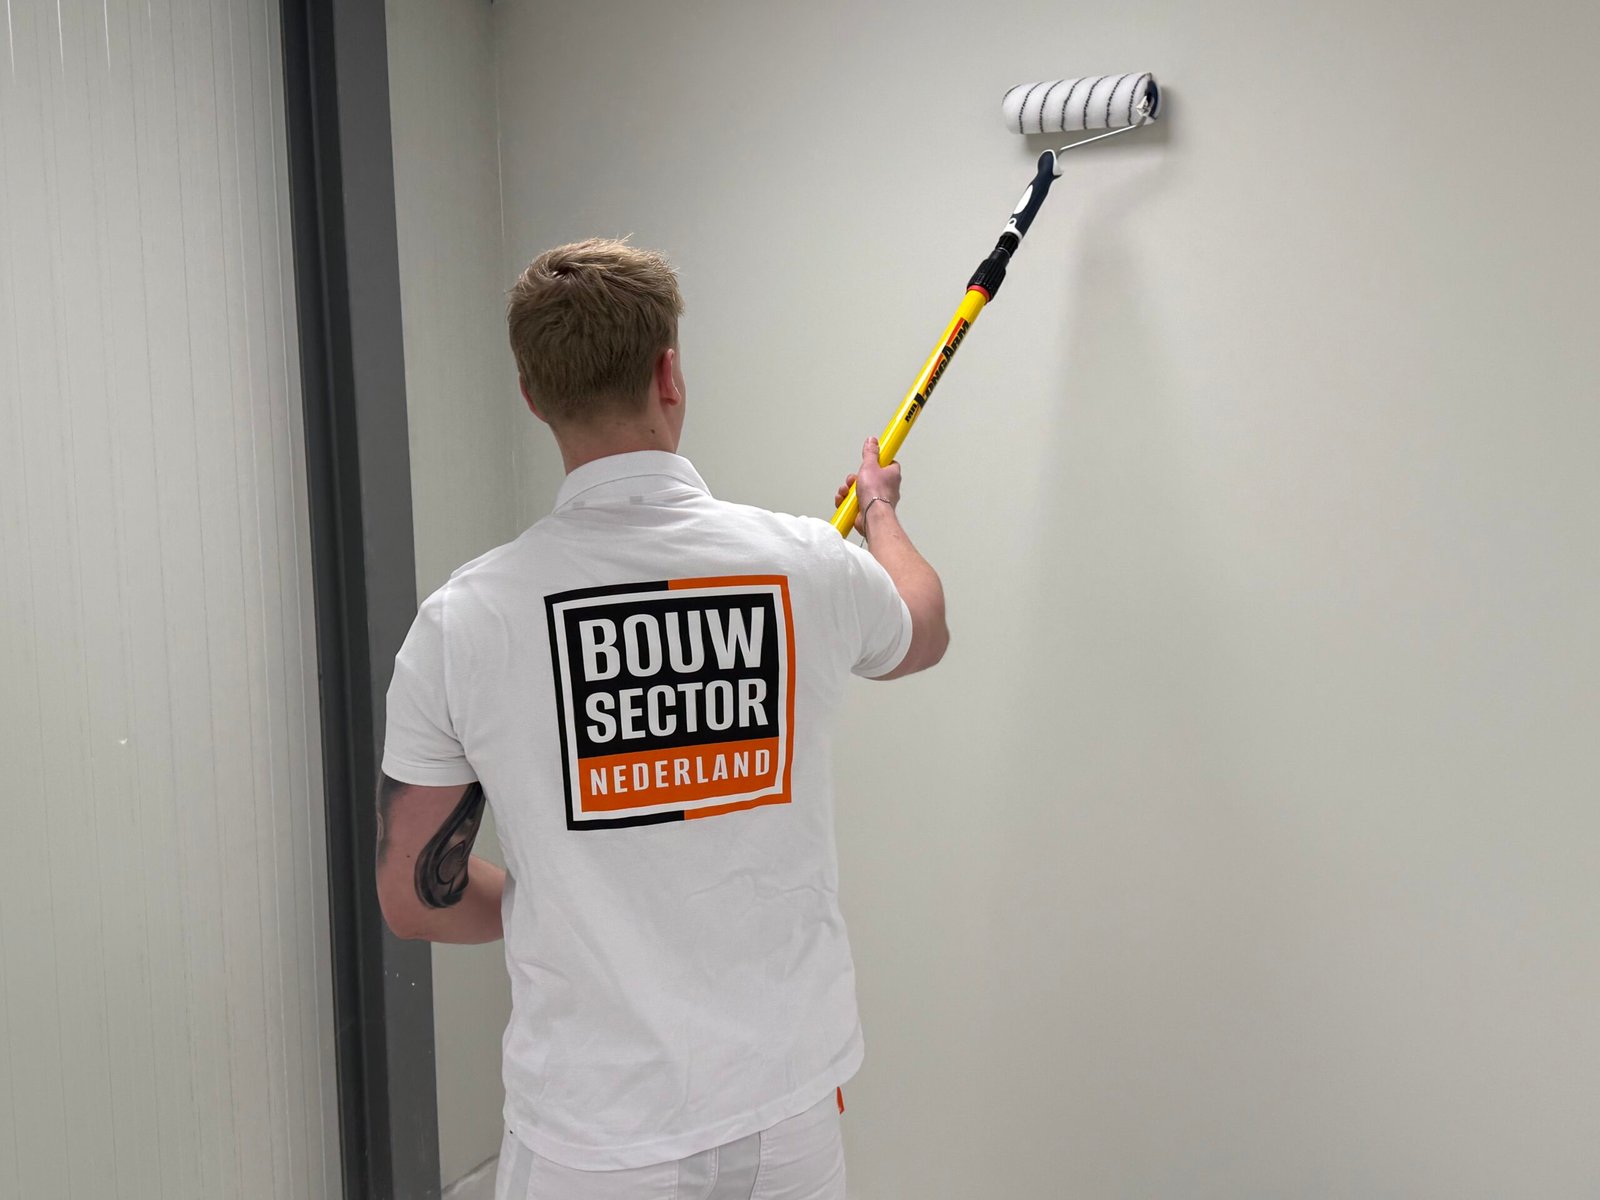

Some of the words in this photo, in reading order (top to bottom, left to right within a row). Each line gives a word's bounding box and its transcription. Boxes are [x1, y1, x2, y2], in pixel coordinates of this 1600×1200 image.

[579, 606, 765, 682] BOUW
[585, 678, 769, 743] SECTOR
[590, 749, 770, 796] NEDERLAND
